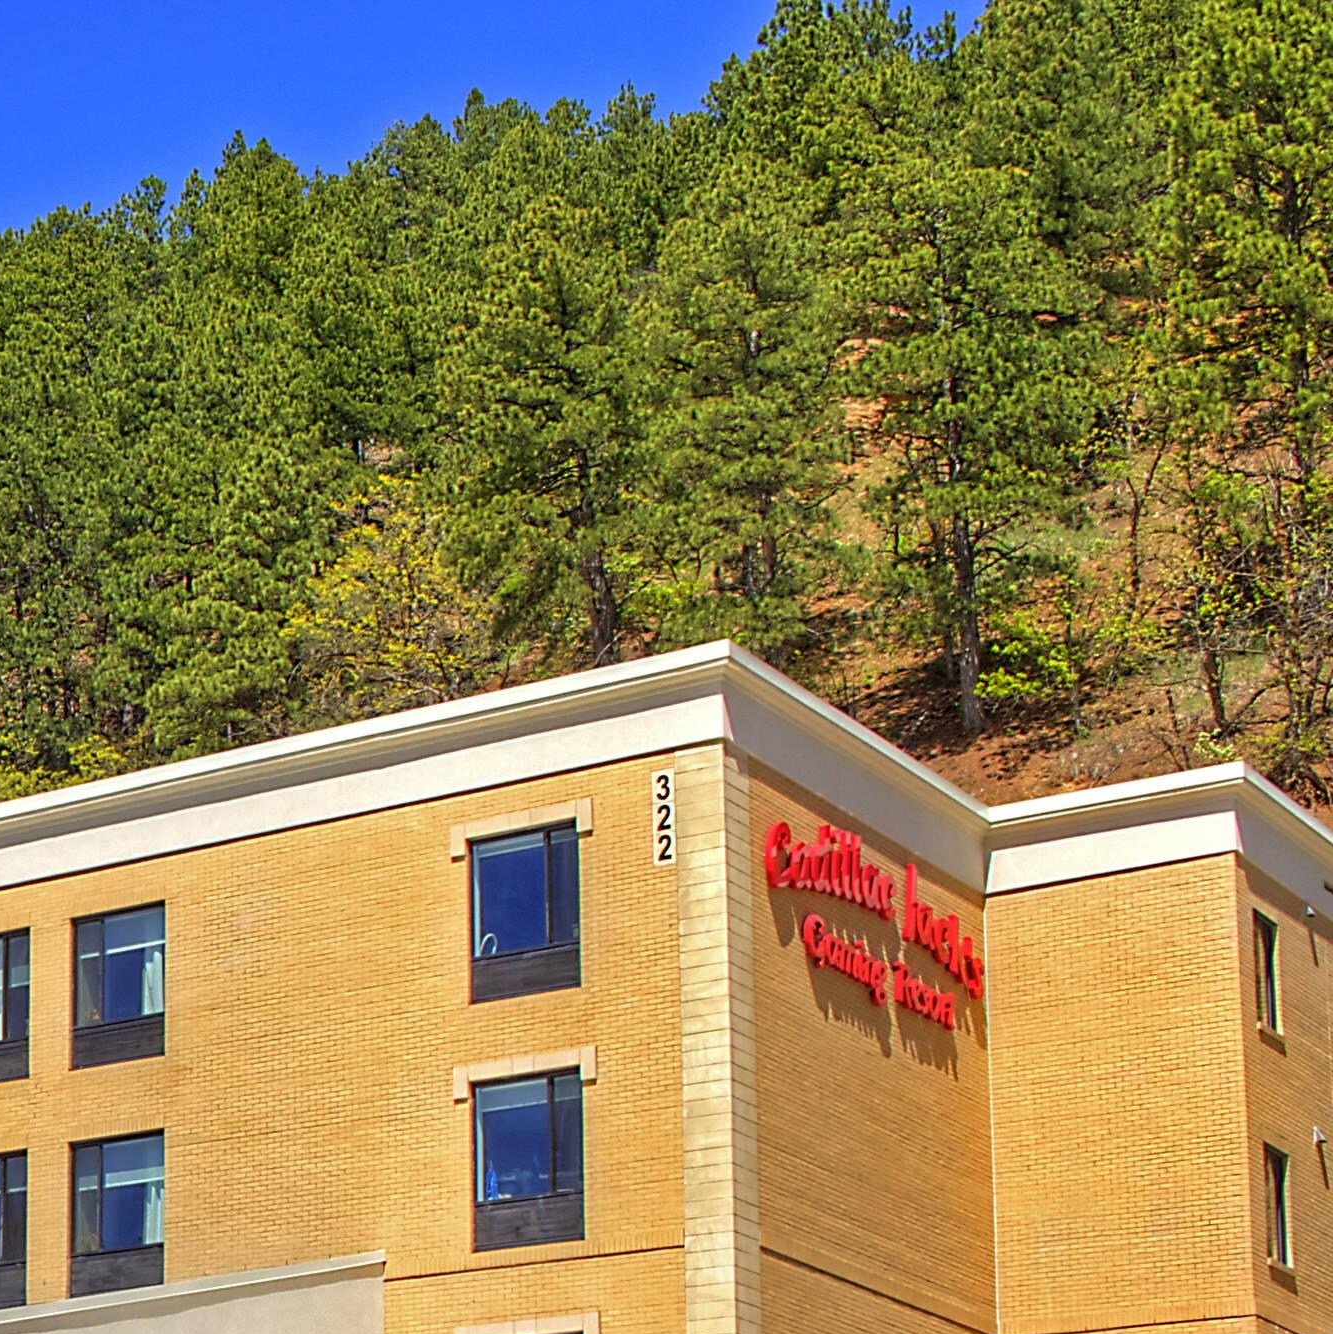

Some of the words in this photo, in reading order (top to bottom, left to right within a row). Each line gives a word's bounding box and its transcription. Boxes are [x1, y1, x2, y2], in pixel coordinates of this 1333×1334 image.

[655, 774, 673, 862] 322
[764, 822, 897, 921] Cadillac
[802, 912, 888, 1006] Gaming
[892, 959, 956, 1031] Resort
